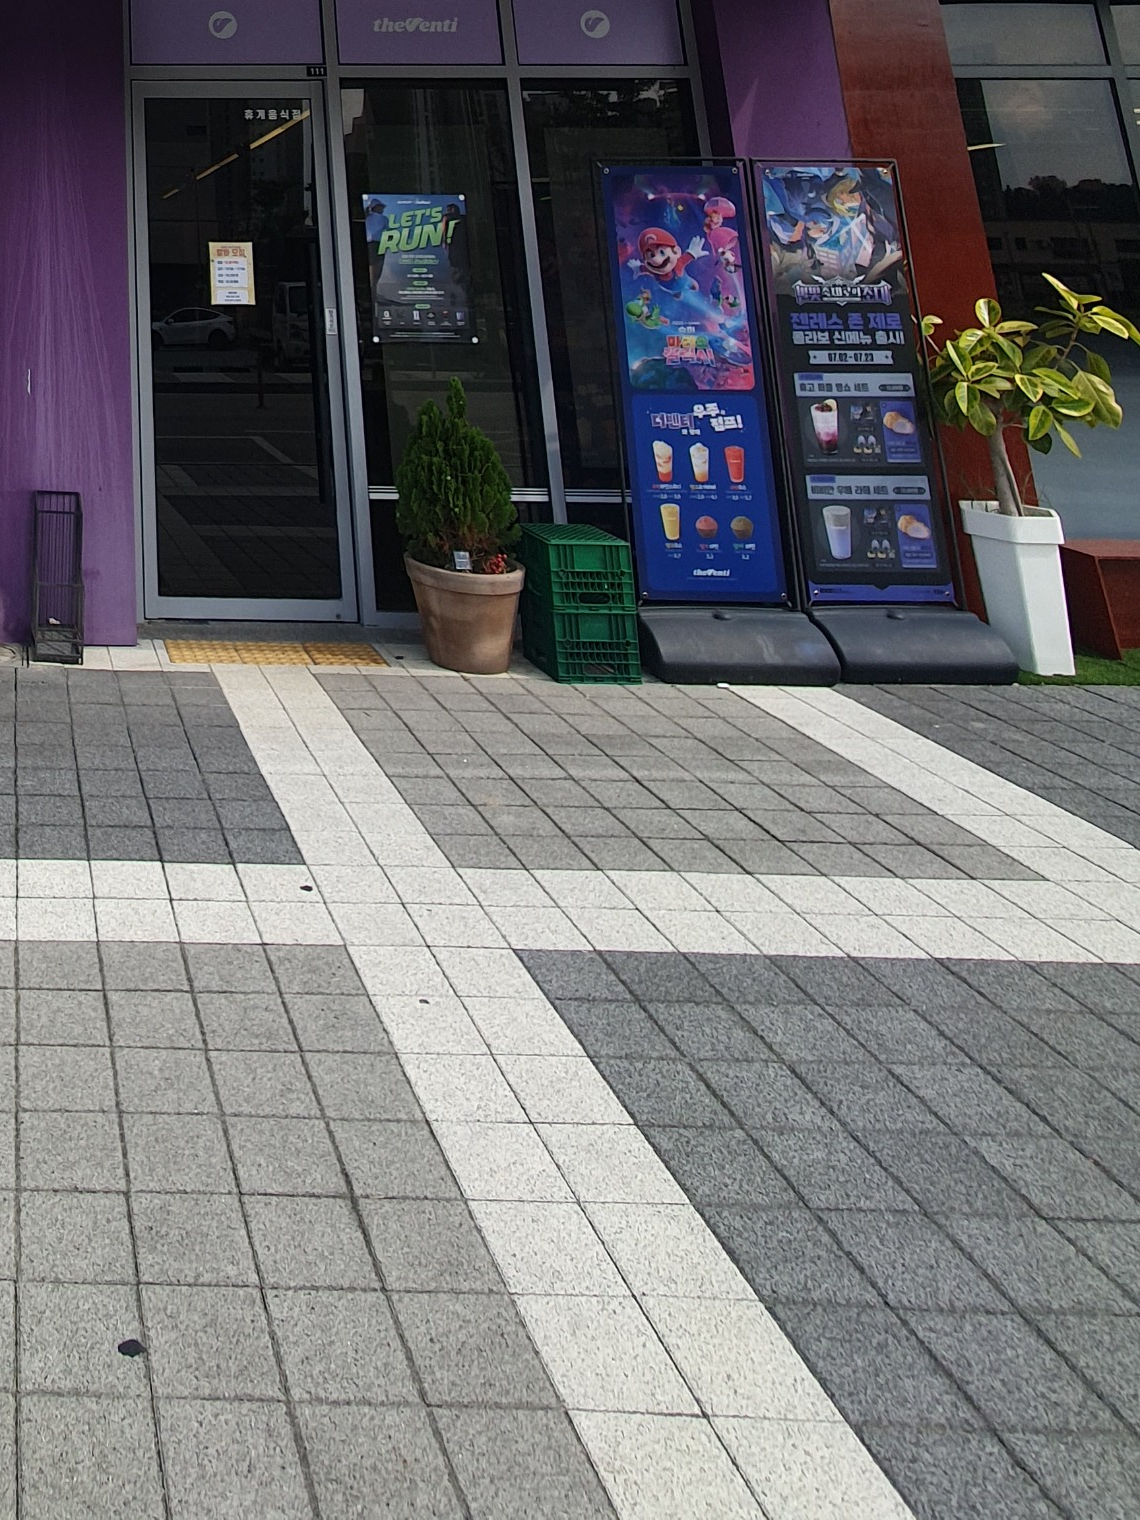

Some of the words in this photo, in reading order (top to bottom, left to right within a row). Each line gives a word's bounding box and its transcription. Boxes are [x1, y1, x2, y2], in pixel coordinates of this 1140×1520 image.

[372, 17, 458, 33] theVenti
[310, 67, 325, 75] 111
[244, 109, 301, 120] 휴게음식점
[388, 206, 442, 229] LET'S
[377, 219, 460, 255] RUN!
[790, 312, 844, 330] 젠레스
[867, 312, 903, 330] 제로
[833, 330, 872, 345] 신메뉴
[650, 412, 695, 430] 더벤티
[693, 568, 730, 577] theVenti
